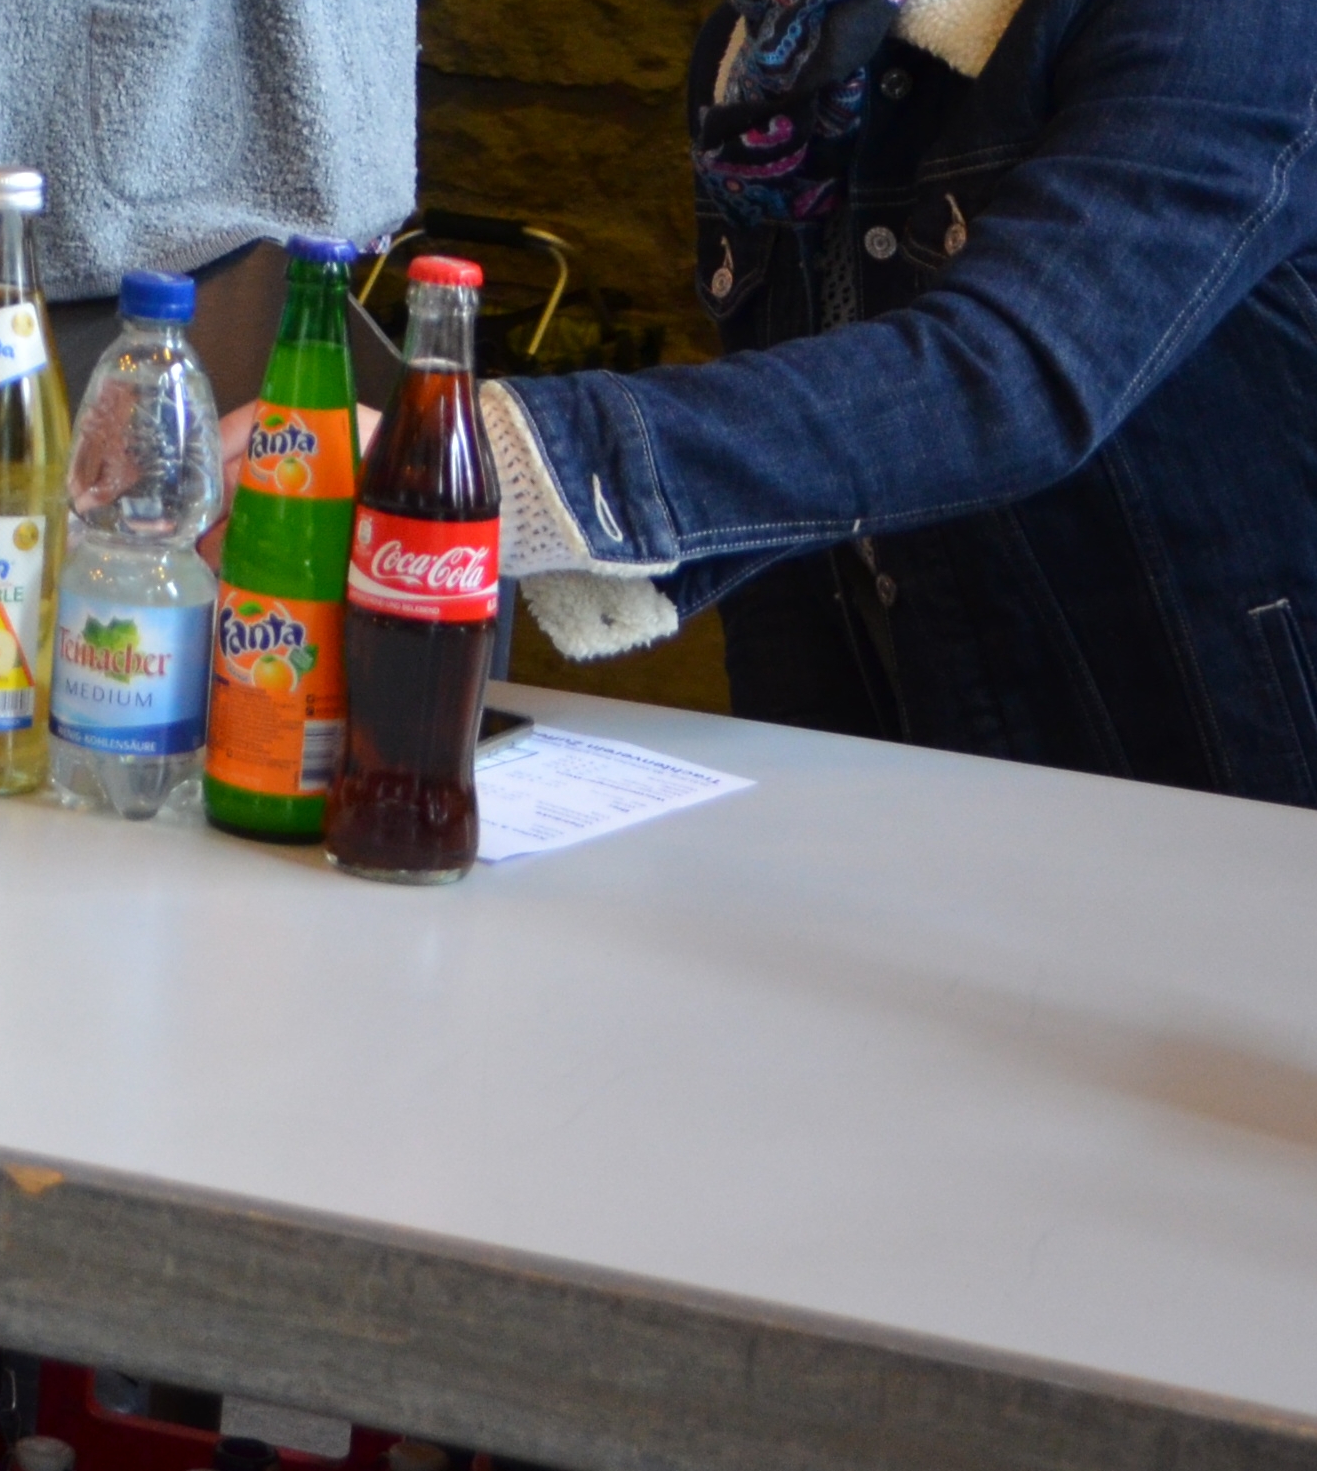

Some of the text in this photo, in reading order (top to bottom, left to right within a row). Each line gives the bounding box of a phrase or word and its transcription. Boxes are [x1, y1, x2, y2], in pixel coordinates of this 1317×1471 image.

[248, 421, 316, 461] Fanta
[371, 540, 489, 590] Coca-Cola
[59, 626, 172, 678] Teinacher
[220, 606, 305, 657] Fanta
[66, 678, 153, 708] MEDIUM
[84, 732, 157, 753] KOHLENSÄURE
